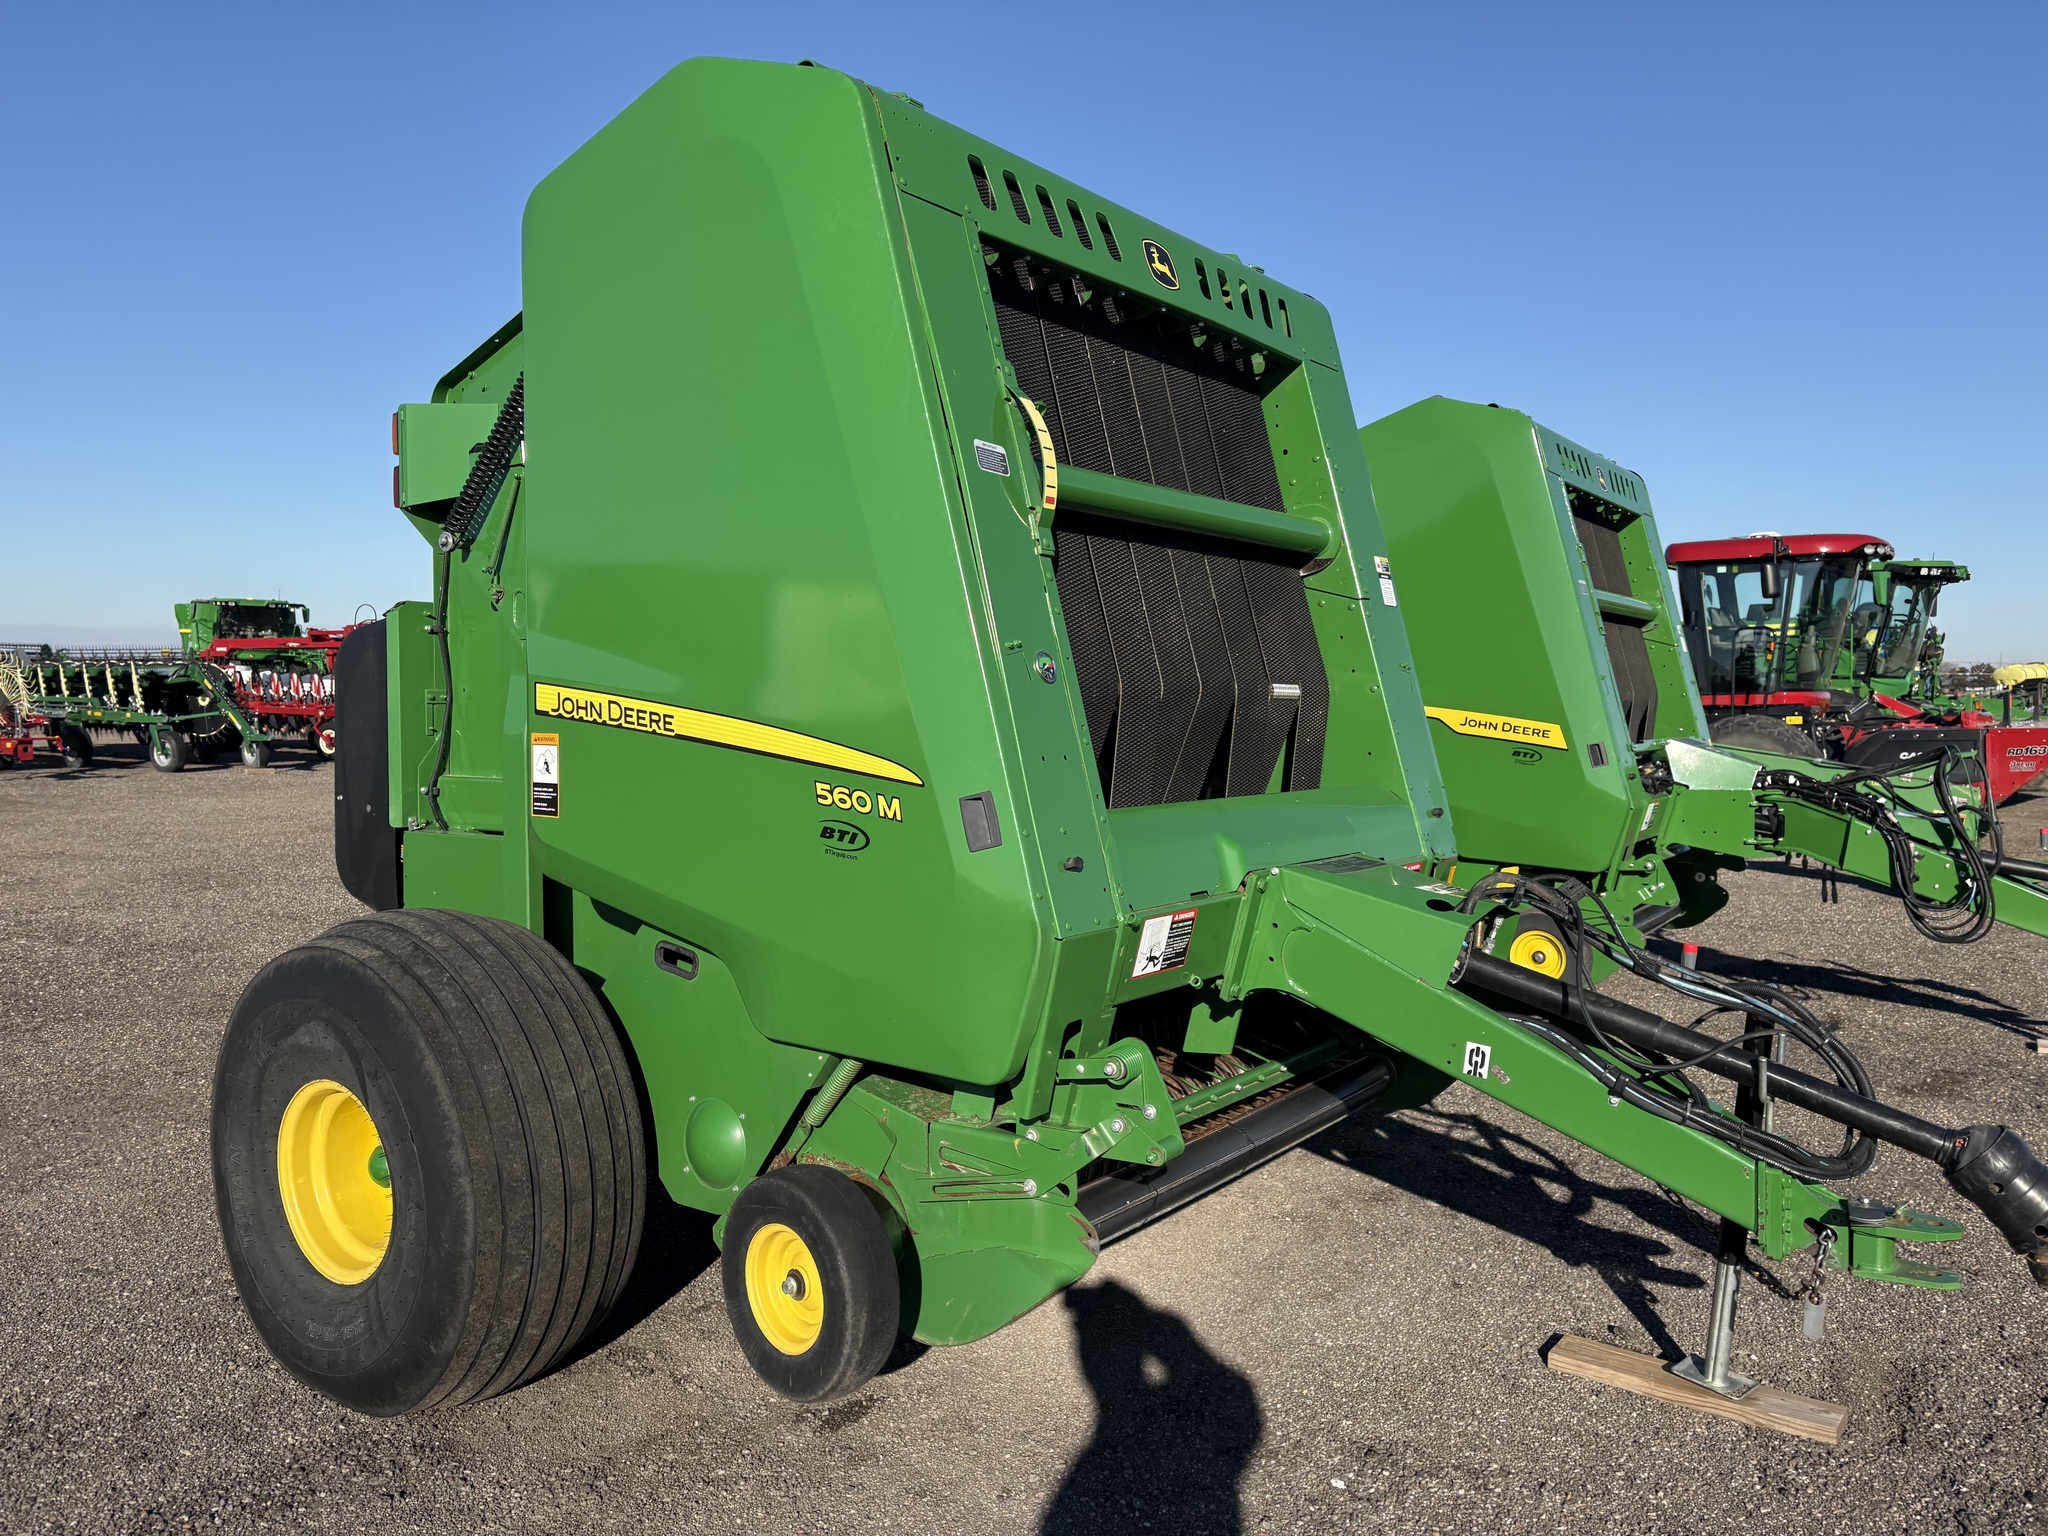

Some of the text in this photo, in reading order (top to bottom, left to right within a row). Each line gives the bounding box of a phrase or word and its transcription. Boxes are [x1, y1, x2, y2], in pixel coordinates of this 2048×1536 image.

[550, 692, 676, 733] JOHN DEERE
[1459, 716, 1552, 739] JOHN DEERE
[1511, 750, 1536, 759] BTI
[2006, 745, 2048, 757] RD163
[814, 780, 903, 823] 560 M
[819, 825, 859, 845] BTI
